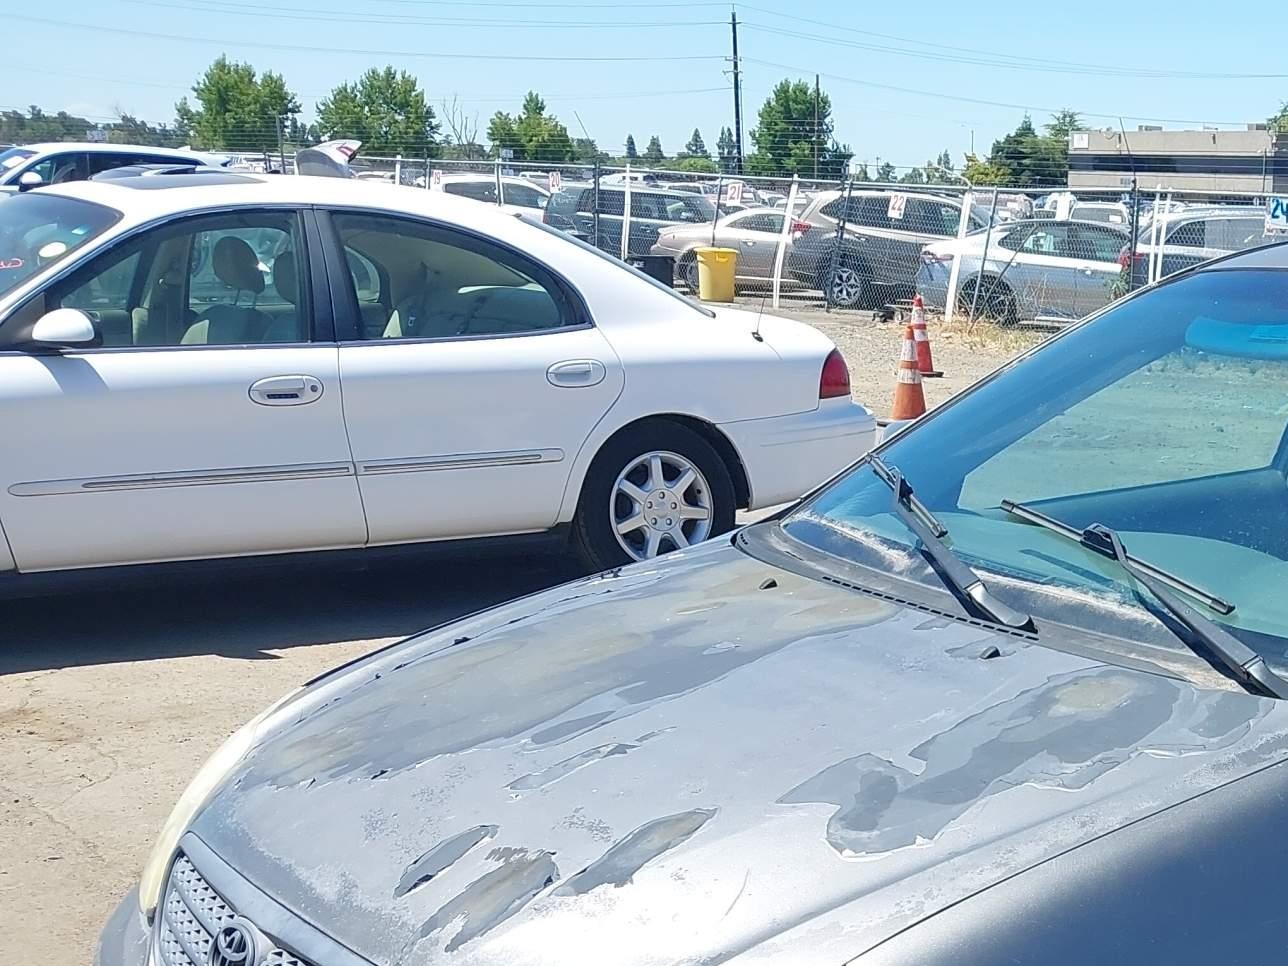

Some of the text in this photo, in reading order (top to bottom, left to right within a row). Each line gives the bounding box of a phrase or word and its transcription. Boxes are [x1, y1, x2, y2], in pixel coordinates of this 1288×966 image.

[728, 184, 741, 201] 21
[891, 194, 905, 212] 22
[1271, 198, 1288, 224] 24
